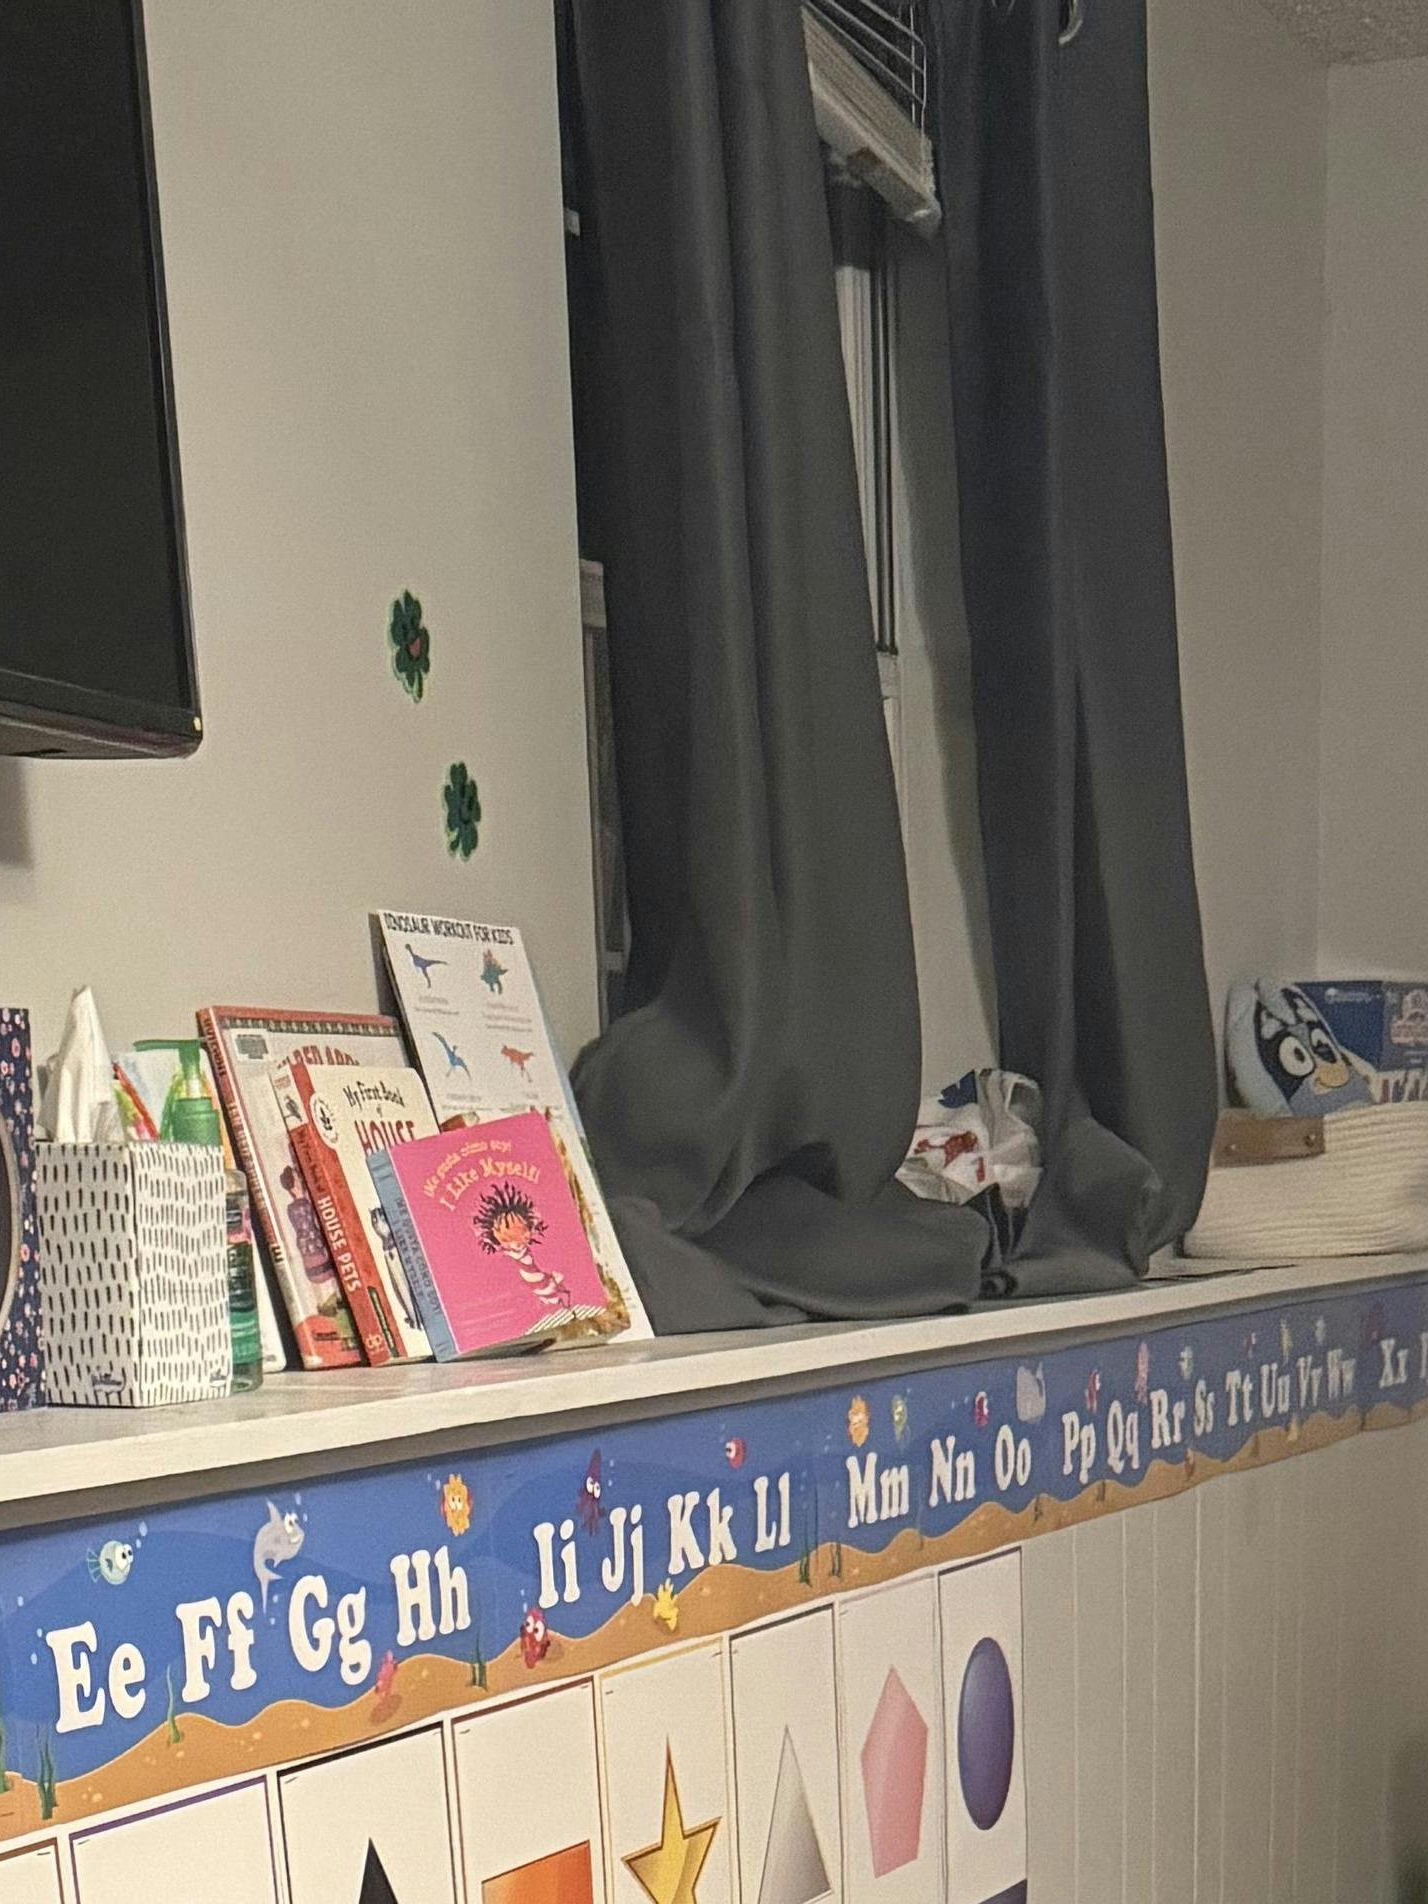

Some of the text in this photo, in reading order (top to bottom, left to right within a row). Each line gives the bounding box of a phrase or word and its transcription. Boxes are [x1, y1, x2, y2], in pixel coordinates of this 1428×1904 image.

[473, 924, 491, 942] FOR
[491, 928, 515, 946] KIDS
[439, 1156, 541, 1211] I Like Myself!
[318, 1196, 346, 1251] HOUSE
[337, 1252, 363, 1293] PETS
[46, 1621, 146, 1734] Ee
[175, 1591, 257, 1703] Ff
[288, 1575, 370, 1686] Gg
[390, 1544, 471, 1646] Hh
[533, 1518, 579, 1609] Ii
[602, 1504, 645, 1604] Jj
[668, 1487, 737, 1575] Kk
[754, 1471, 792, 1553] Ll
[846, 1451, 910, 1529] Mm
[929, 1435, 976, 1508] Nn
[994, 1425, 1032, 1491] Oo
[1061, 1410, 1097, 1485] Pp
[1107, 1399, 1140, 1474] Qq
[1149, 1388, 1186, 1449] Rr
[1194, 1379, 1215, 1437] Ss
[1225, 1369, 1254, 1426] Tt
[1260, 1362, 1291, 1419] Uu
[1296, 1355, 1322, 1408] Vv
[1327, 1348, 1357, 1399] Ww
[1378, 1338, 1409, 1390] Xx
